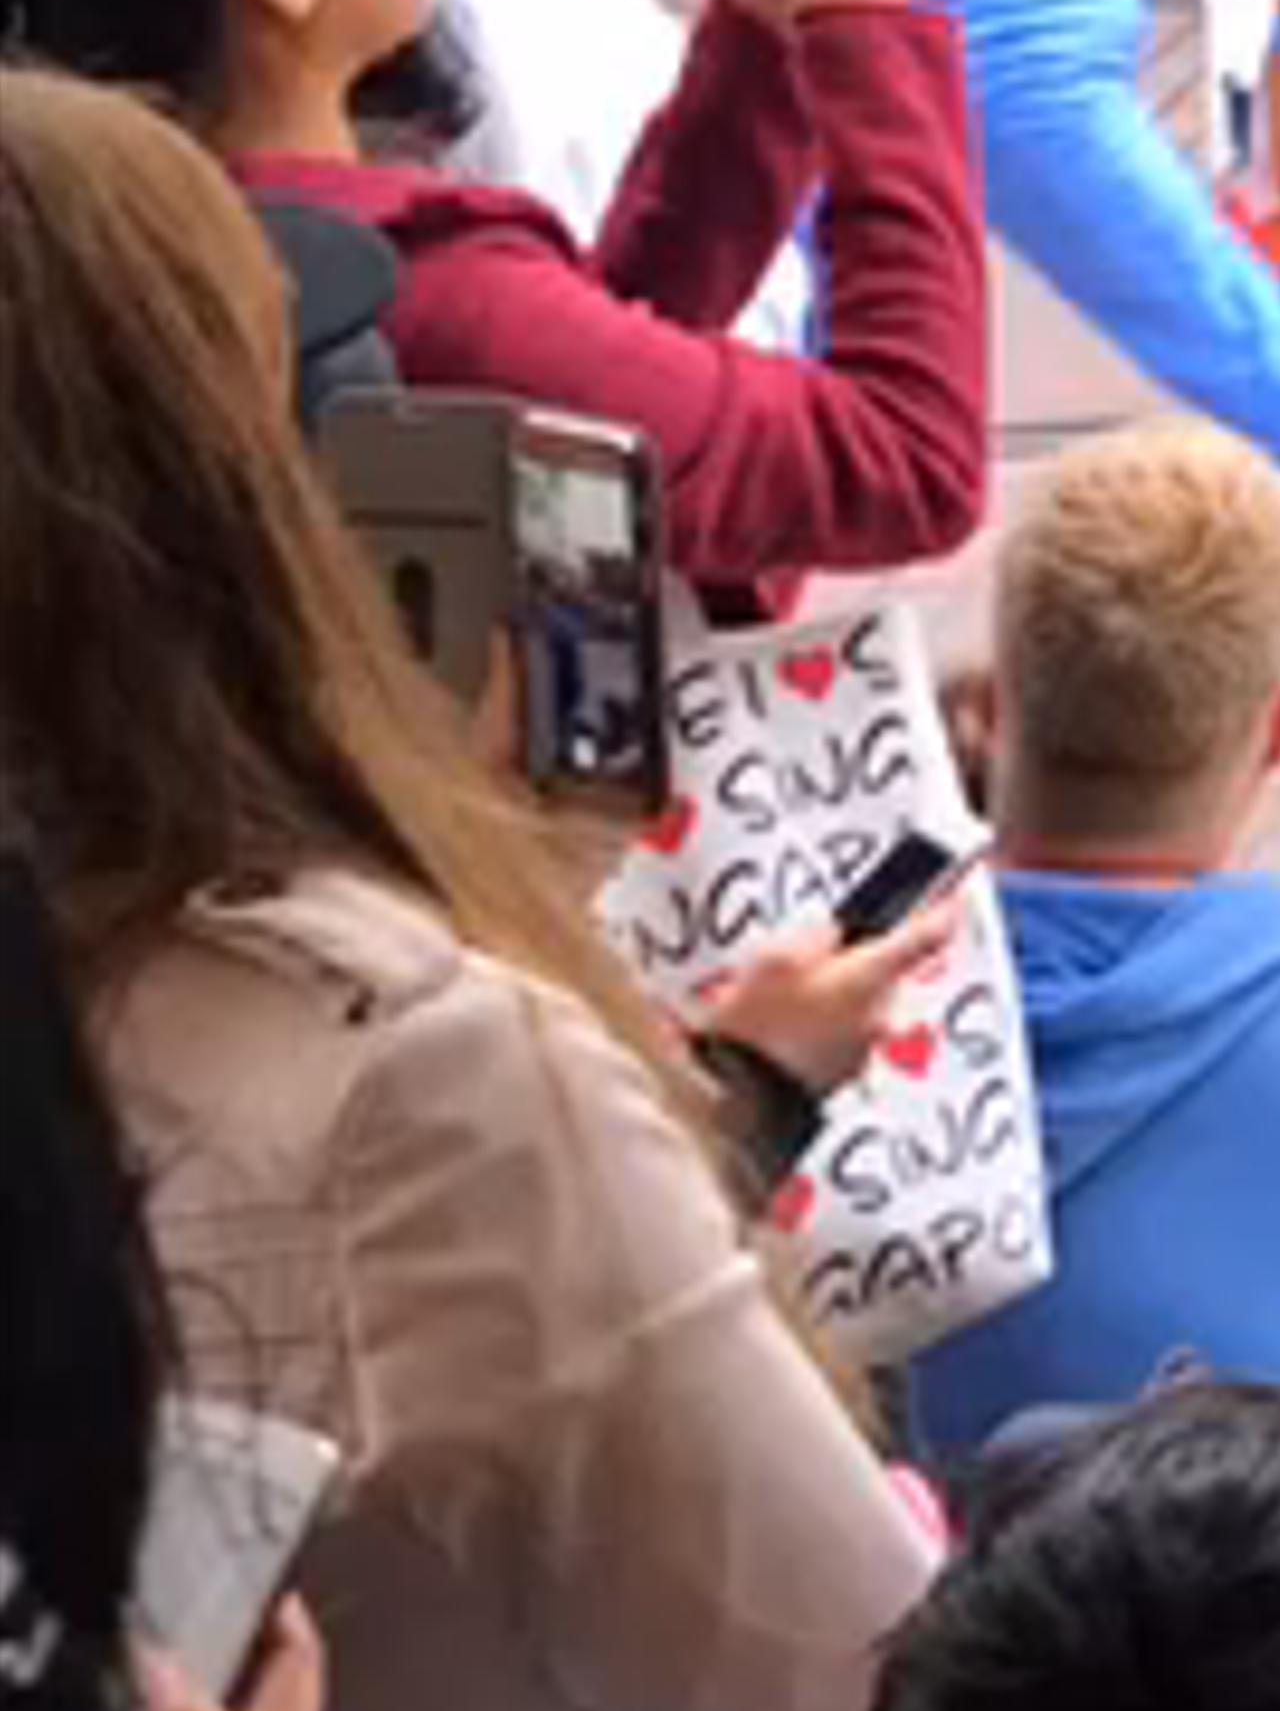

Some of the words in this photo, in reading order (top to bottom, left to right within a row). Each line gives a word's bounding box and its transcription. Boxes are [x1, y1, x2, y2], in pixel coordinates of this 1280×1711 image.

[716, 708, 916, 833] SING
[632, 816, 910, 973] NGAP
[830, 1077, 1018, 1213] SING
